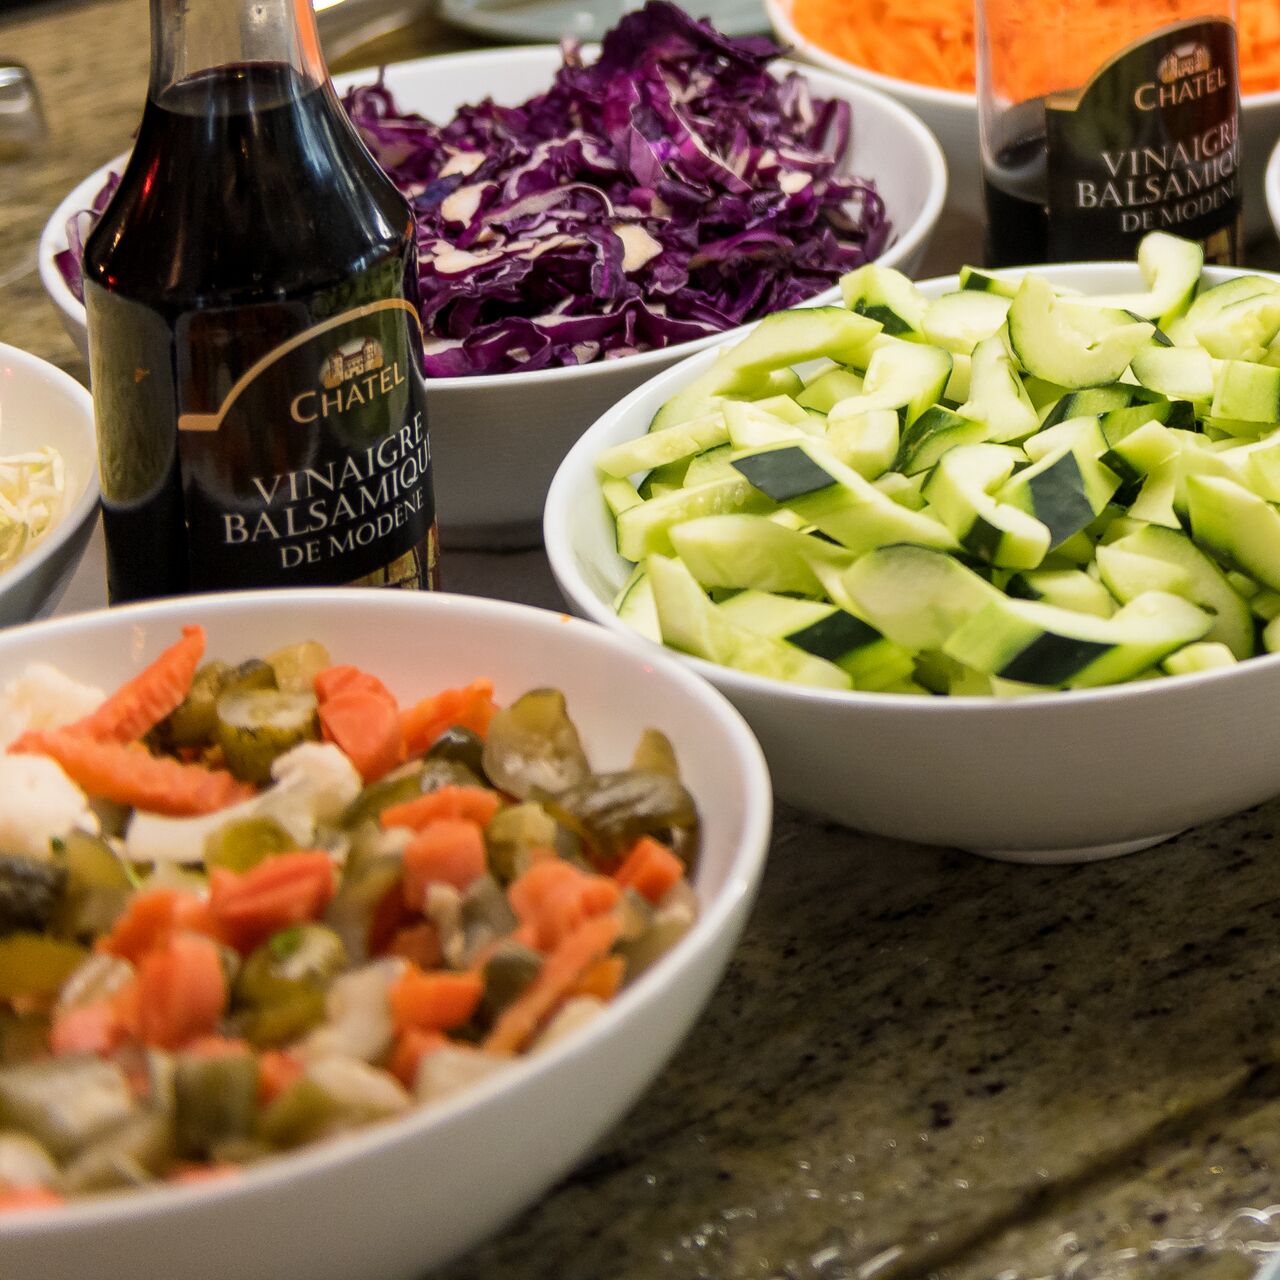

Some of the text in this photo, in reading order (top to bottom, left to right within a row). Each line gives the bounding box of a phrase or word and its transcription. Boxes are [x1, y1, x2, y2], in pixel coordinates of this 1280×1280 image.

[1076, 140, 1240, 209] BALSAMIQU
[1121, 210, 1153, 233] DE
[252, 411, 424, 506] VINAIGRE
[279, 540, 321, 569] DE
